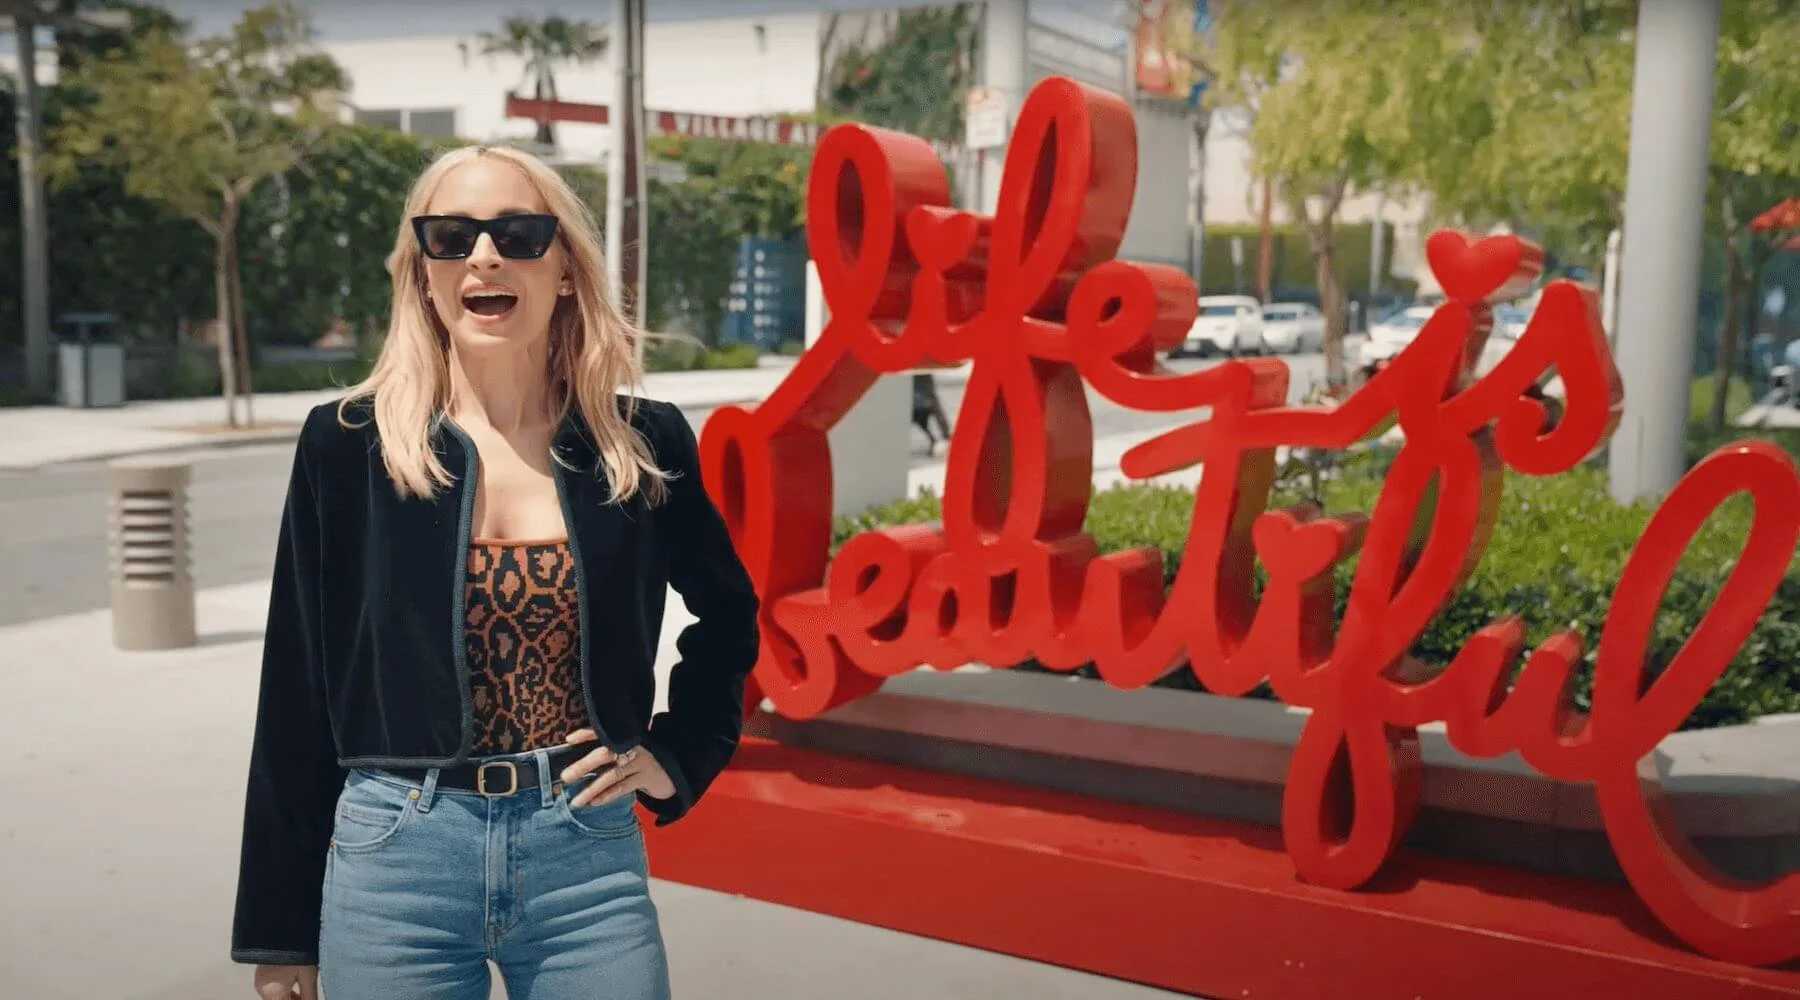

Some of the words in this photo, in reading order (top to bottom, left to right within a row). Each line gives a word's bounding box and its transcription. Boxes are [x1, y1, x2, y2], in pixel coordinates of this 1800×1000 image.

[674, 112, 779, 142] VILLAGE
[808, 76, 1199, 548] life
[1375, 229, 1621, 475] is
[699, 359, 1800, 967] beautiful
